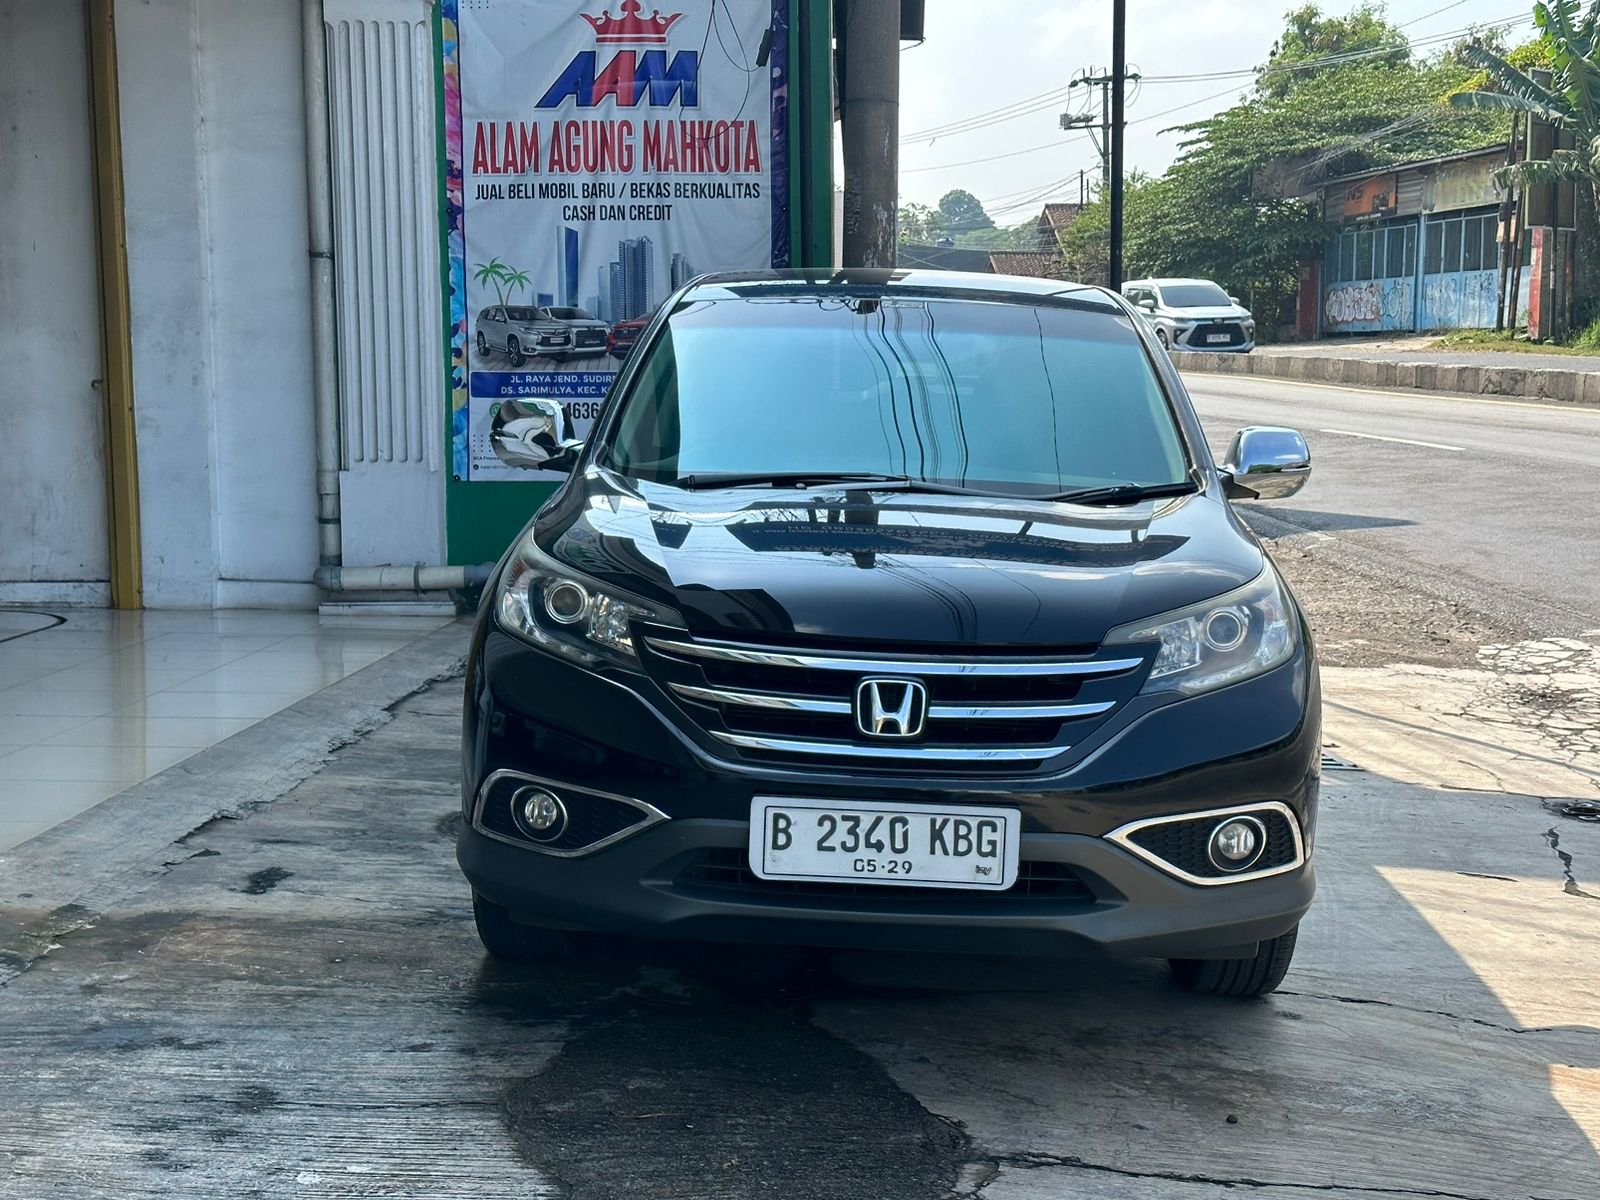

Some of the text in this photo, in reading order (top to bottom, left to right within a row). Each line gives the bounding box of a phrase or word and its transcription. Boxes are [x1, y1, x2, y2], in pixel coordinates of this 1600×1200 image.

[534, 50, 698, 108] AAM
[472, 119, 761, 175] ALAM AGUNG MAHKOTA
[475, 184, 505, 200] JUAL
[508, 183, 535, 200] BELI
[538, 183, 579, 200] MOBIL
[581, 182, 616, 199] BARU
[630, 182, 671, 199] BEKAS
[674, 182, 761, 199] BERKUALITAS
[563, 204, 673, 221] CASH DAN CREDIT
[510, 375, 524, 384] JL.
[526, 375, 551, 383] RAYA
[553, 375, 581, 383] JEND.
[501, 386, 516, 394] DS.
[577, 386, 599, 394] KEC.
[771, 812, 998, 858] B 2340 KBG
